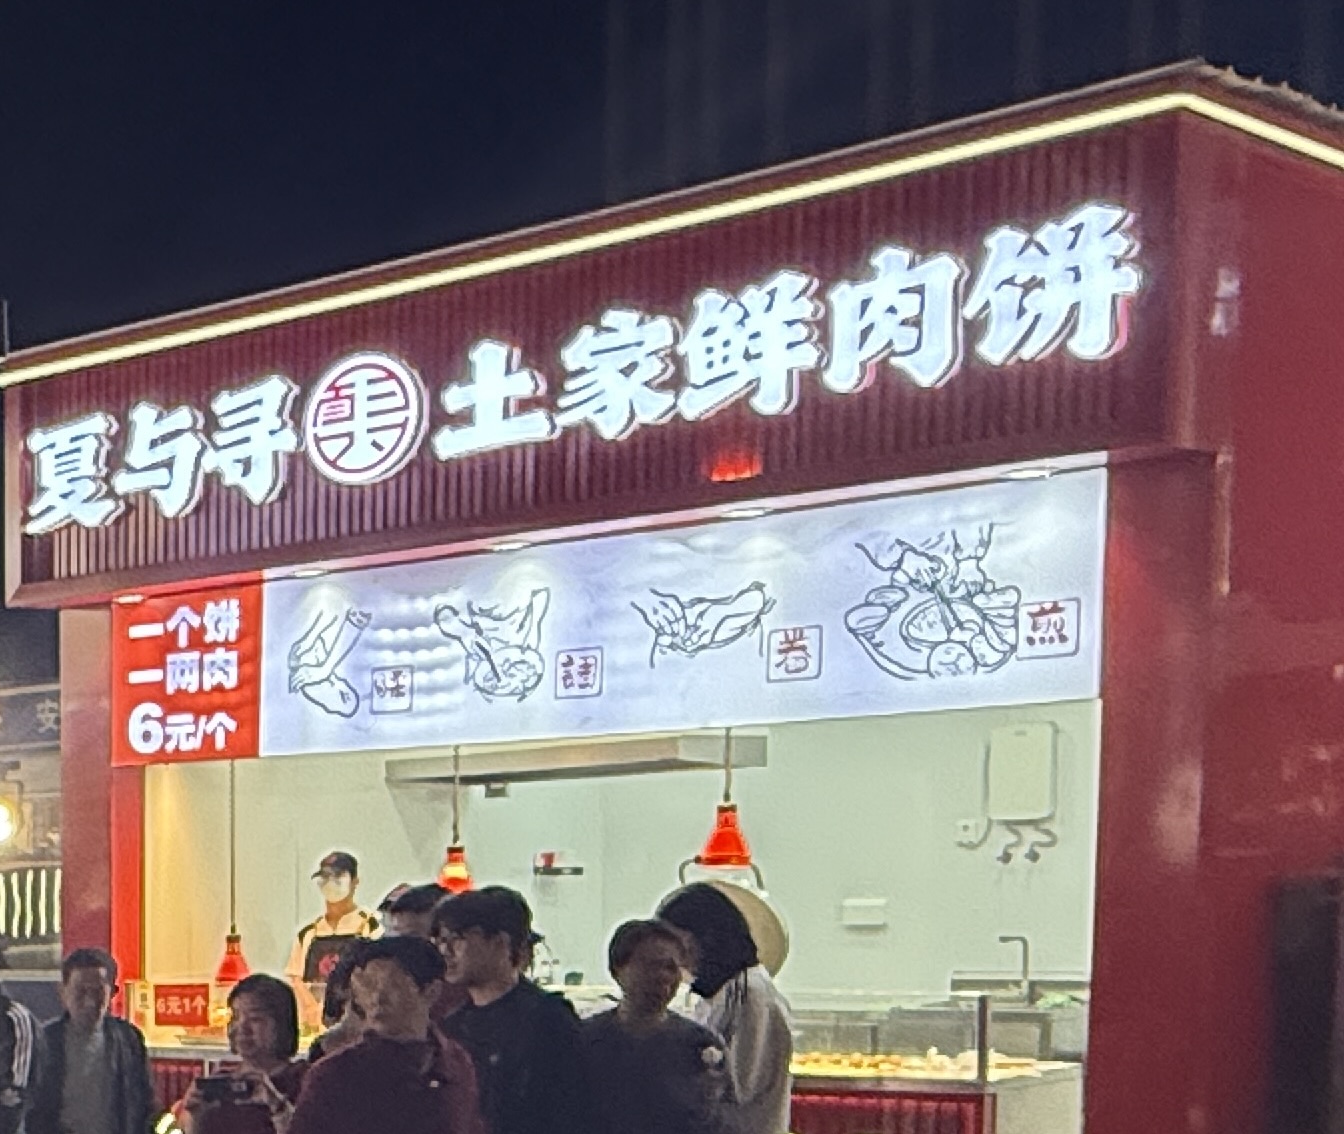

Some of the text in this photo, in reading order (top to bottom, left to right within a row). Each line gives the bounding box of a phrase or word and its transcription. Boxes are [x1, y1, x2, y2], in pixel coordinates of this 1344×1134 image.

[24, 374, 300, 535] 夏与寻
[431, 203, 1141, 462] 土家鲜肉饼
[127, 598, 240, 648] 一个饼
[127, 647, 239, 695] 一两肉
[127, 701, 238, 754] 6元/个
[156, 994, 207, 1017] 6元1个
